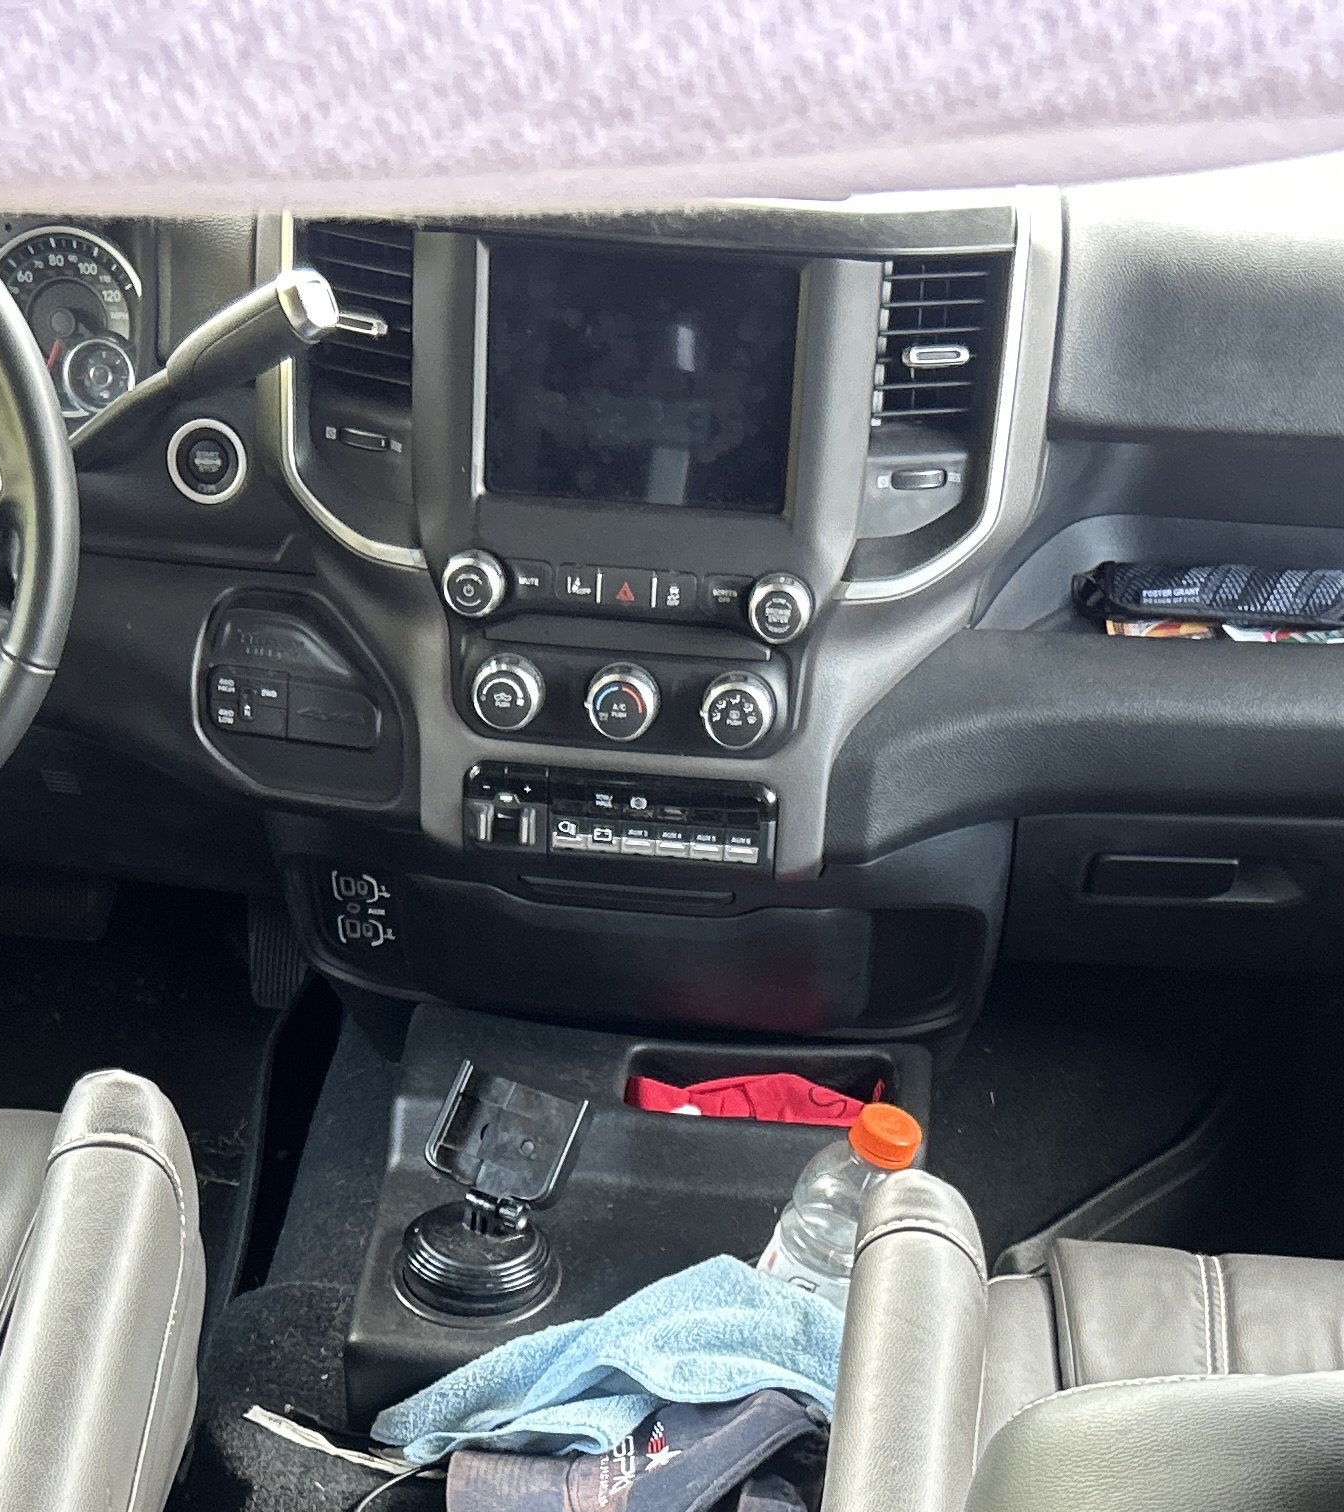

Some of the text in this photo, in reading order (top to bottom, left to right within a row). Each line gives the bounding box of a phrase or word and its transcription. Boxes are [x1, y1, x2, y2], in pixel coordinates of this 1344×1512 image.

[48, 254, 64, 267] 80
[78, 263, 98, 276] 100
[17, 270, 33, 283] 60
[102, 290, 121, 302] 120
[1142, 587, 1200, 598] FOSTER GRANT
[612, 703, 626, 711] A/C
